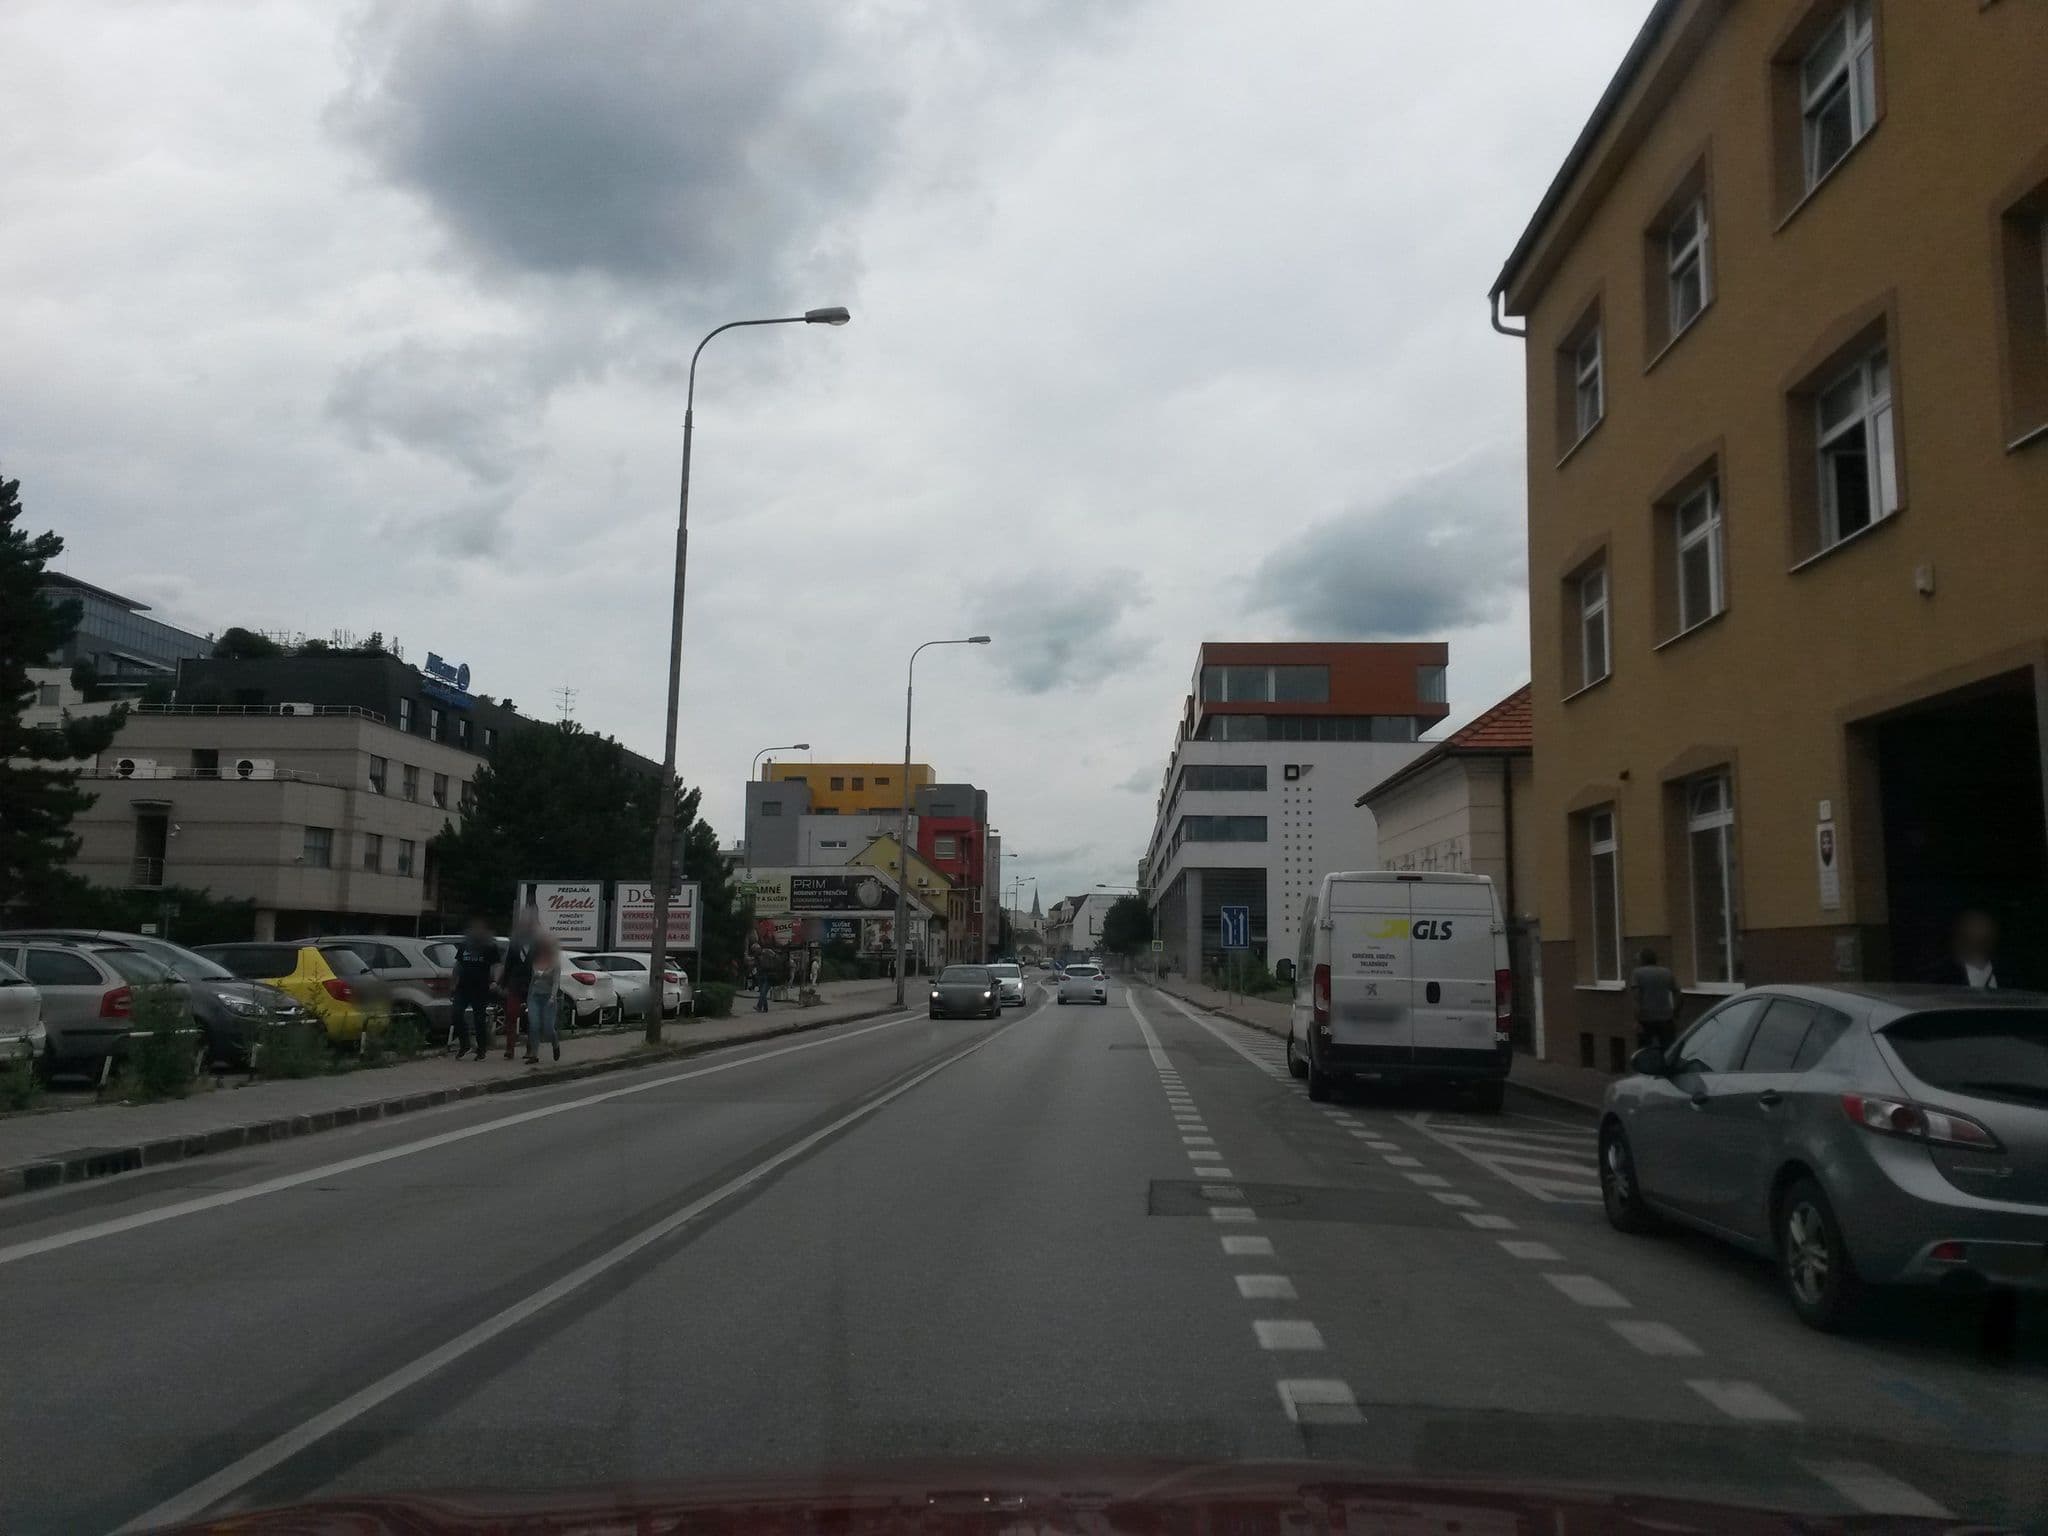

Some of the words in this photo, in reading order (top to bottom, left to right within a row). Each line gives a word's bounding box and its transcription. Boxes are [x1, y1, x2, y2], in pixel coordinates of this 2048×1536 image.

[793, 880, 826, 888] PRIM
[548, 895, 595, 909] Natali
[1412, 920, 1453, 940] GLS
